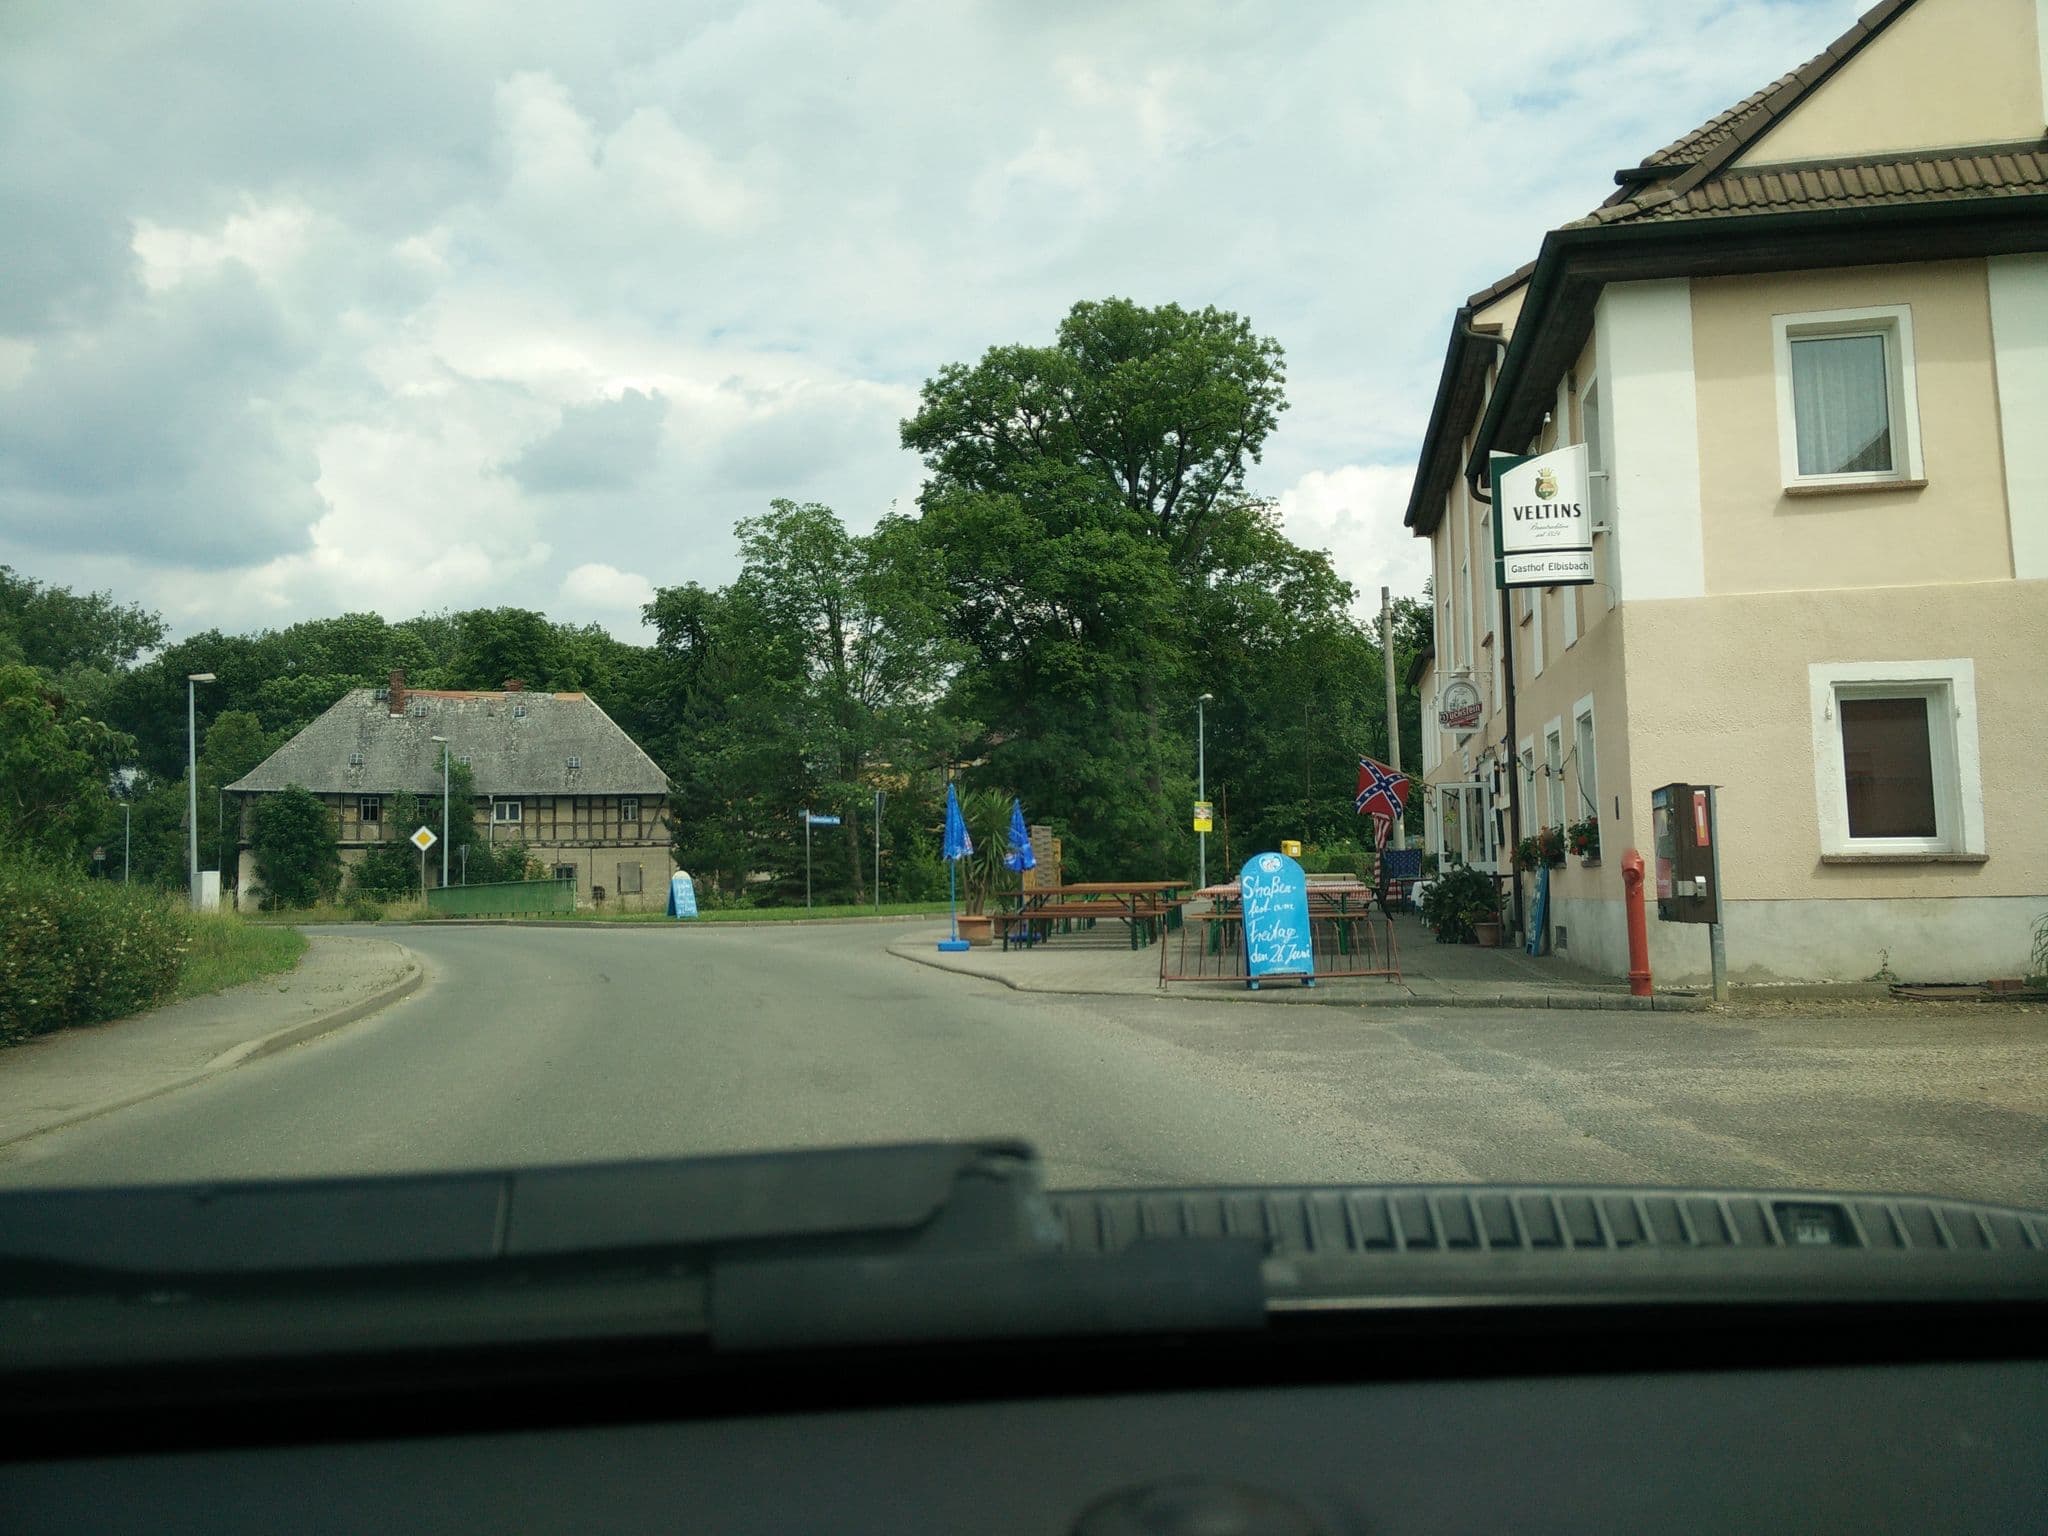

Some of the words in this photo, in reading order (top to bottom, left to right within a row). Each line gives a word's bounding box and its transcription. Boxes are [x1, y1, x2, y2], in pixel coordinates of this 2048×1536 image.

[1513, 503, 1581, 521] VELTINS
[1511, 563, 1545, 573] Gasthof
[1548, 561, 1589, 571] Elbisbach
[1248, 916, 1299, 944] Freitag
[1250, 943, 1268, 963] den
